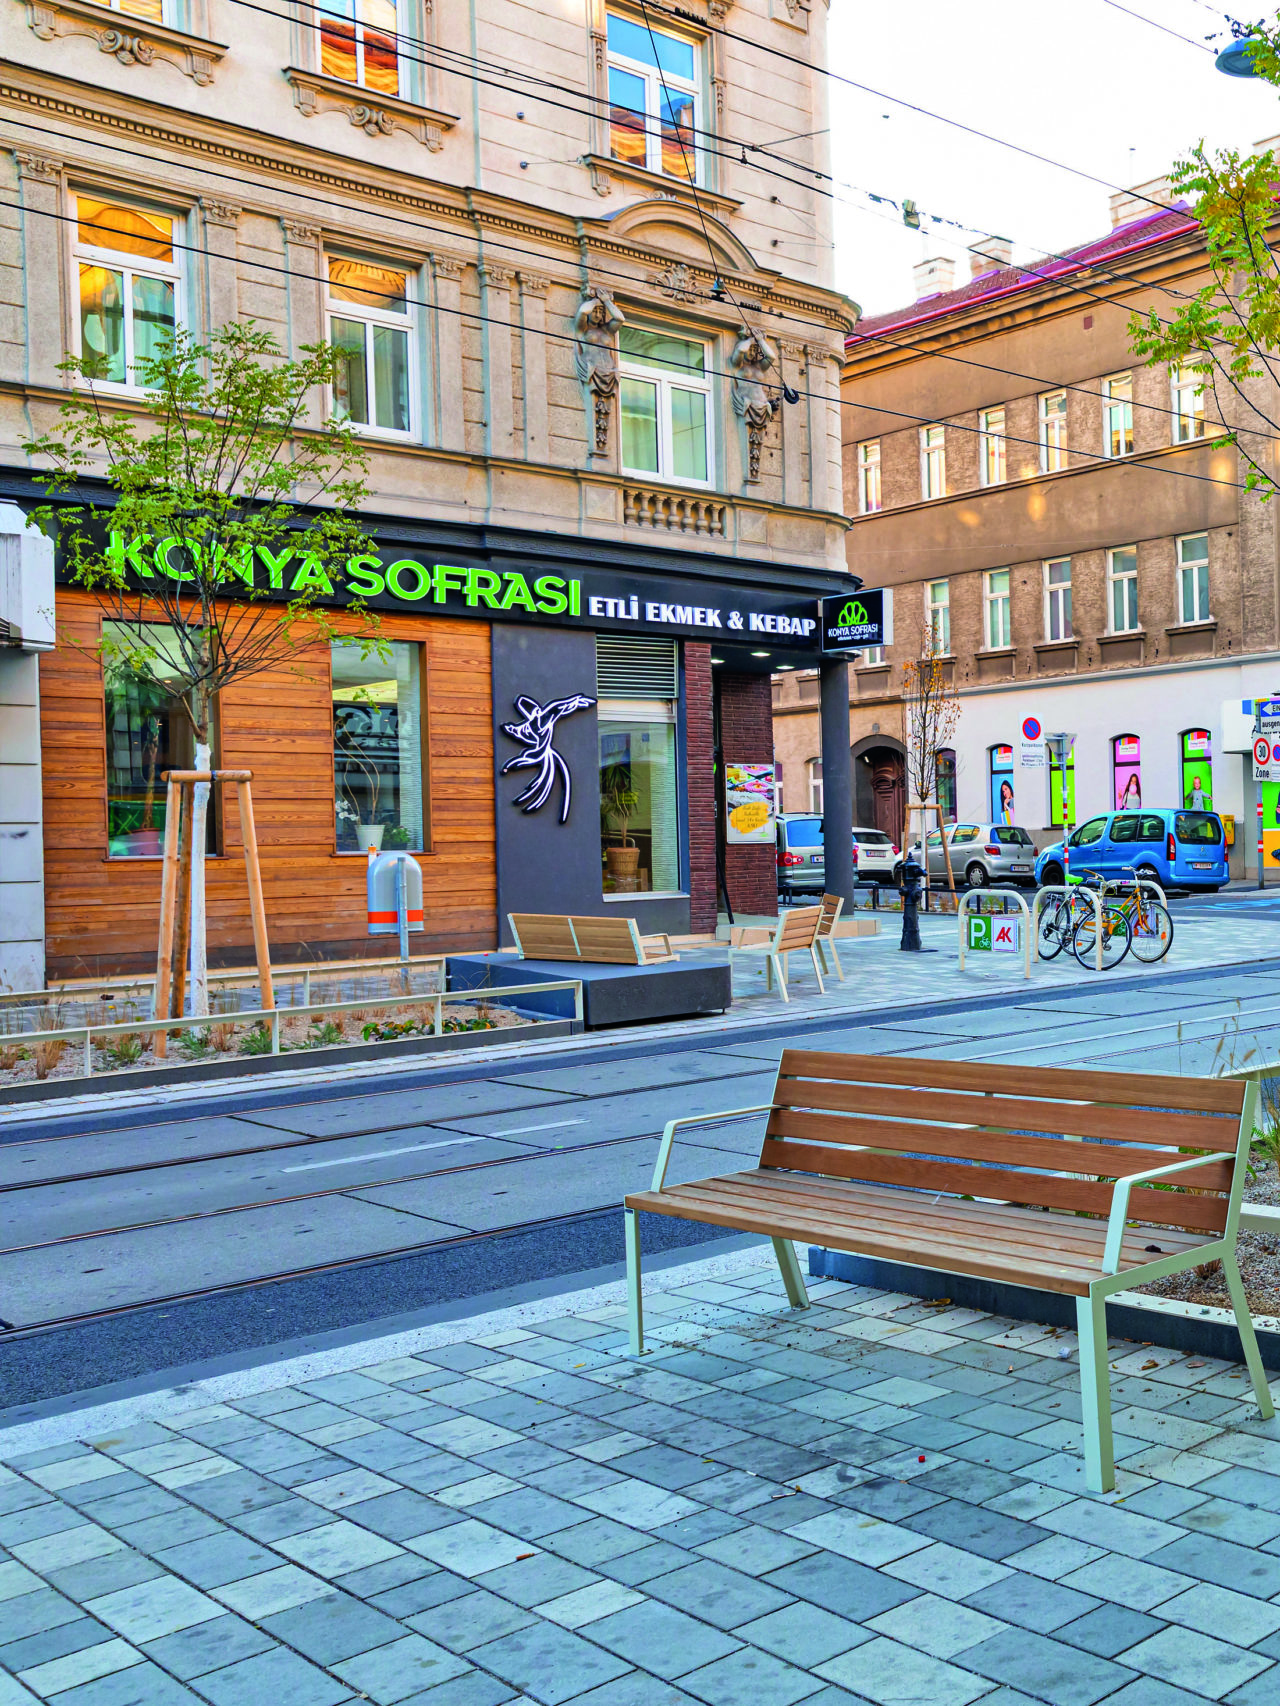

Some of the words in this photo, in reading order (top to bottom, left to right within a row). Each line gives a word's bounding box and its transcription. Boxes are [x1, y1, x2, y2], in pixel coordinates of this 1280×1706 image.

[105, 530, 334, 594] KONYA
[346, 554, 581, 616] SOFRASI
[646, 602, 722, 628] EKMEK
[727, 610, 744, 630] &
[749, 612, 816, 637] KEBAP
[828, 627, 849, 638] KONYA
[850, 623, 878, 635] SOFRASI
[1258, 745, 1266, 758] 30
[1255, 767, 1270, 778] Zone
[970, 918, 986, 947] P
[995, 926, 1012, 943] AK
